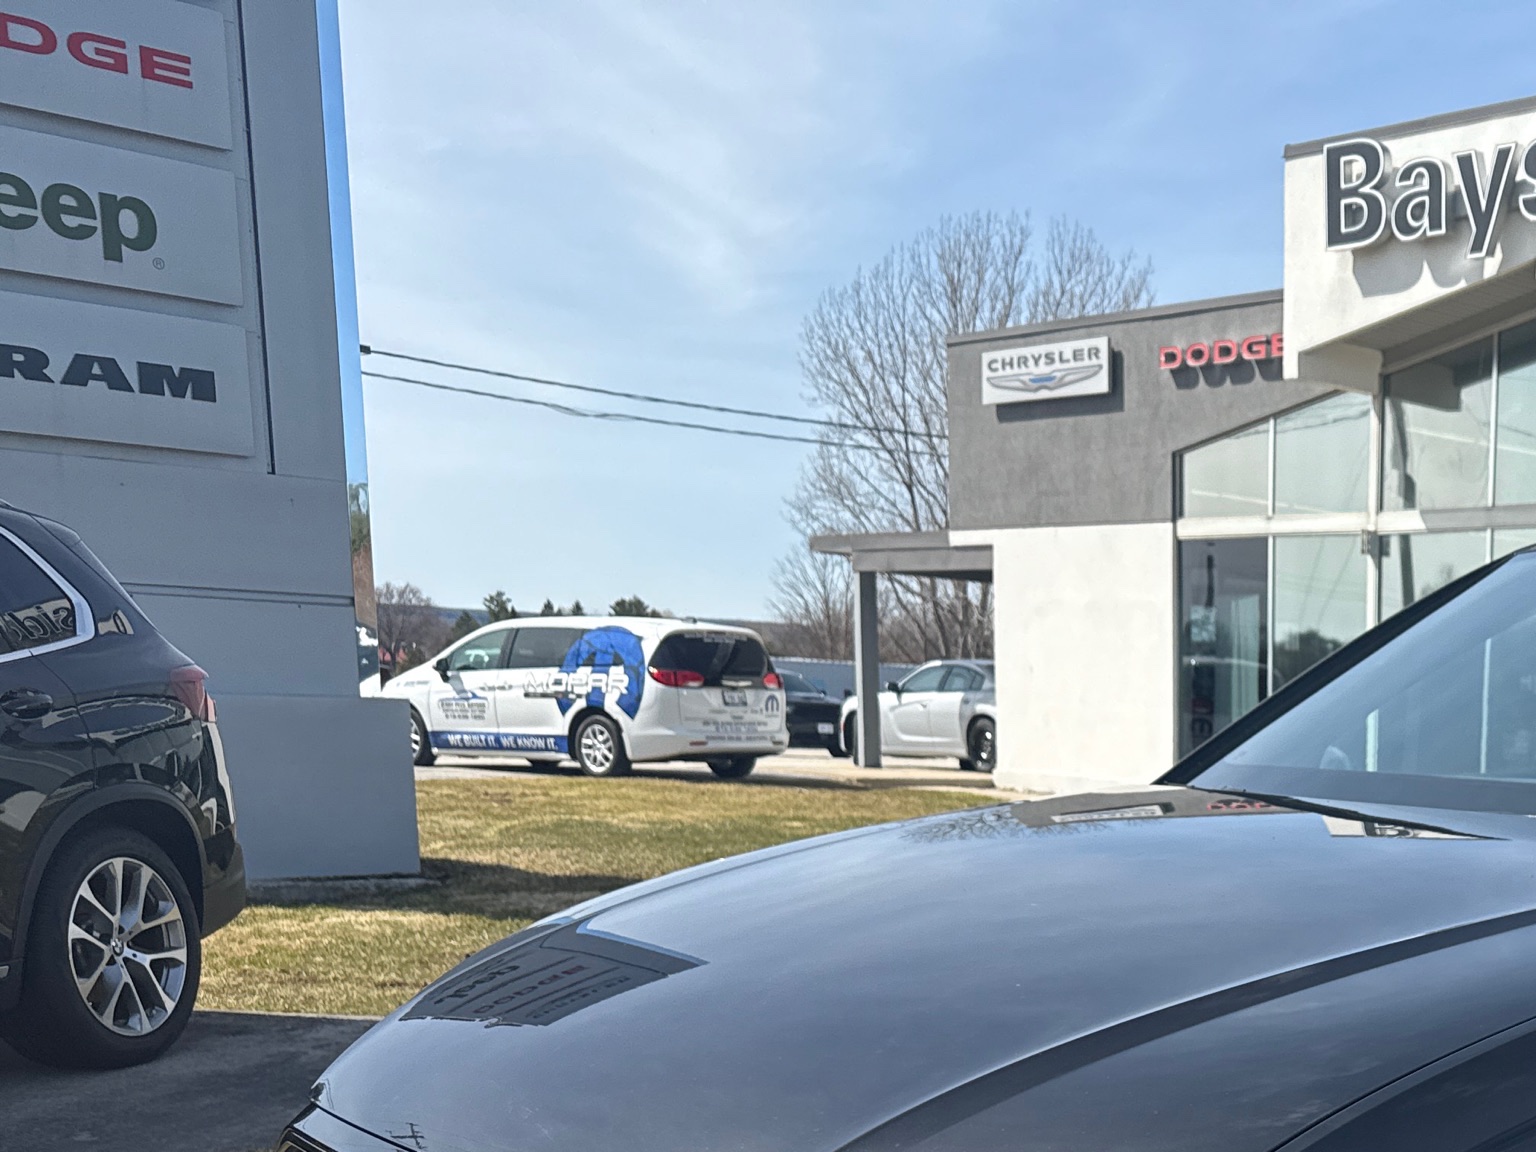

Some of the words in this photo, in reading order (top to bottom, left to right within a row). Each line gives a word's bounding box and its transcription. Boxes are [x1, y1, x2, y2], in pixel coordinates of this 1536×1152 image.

[0, 343, 217, 402] RAM
[987, 347, 1101, 373] CHRYSLER
[522, 670, 630, 695] MOPAR
[447, 733, 461, 747] WE
[463, 734, 486, 748] BUILT
[501, 735, 516, 749] WE
[517, 736, 546, 750] KNOW
